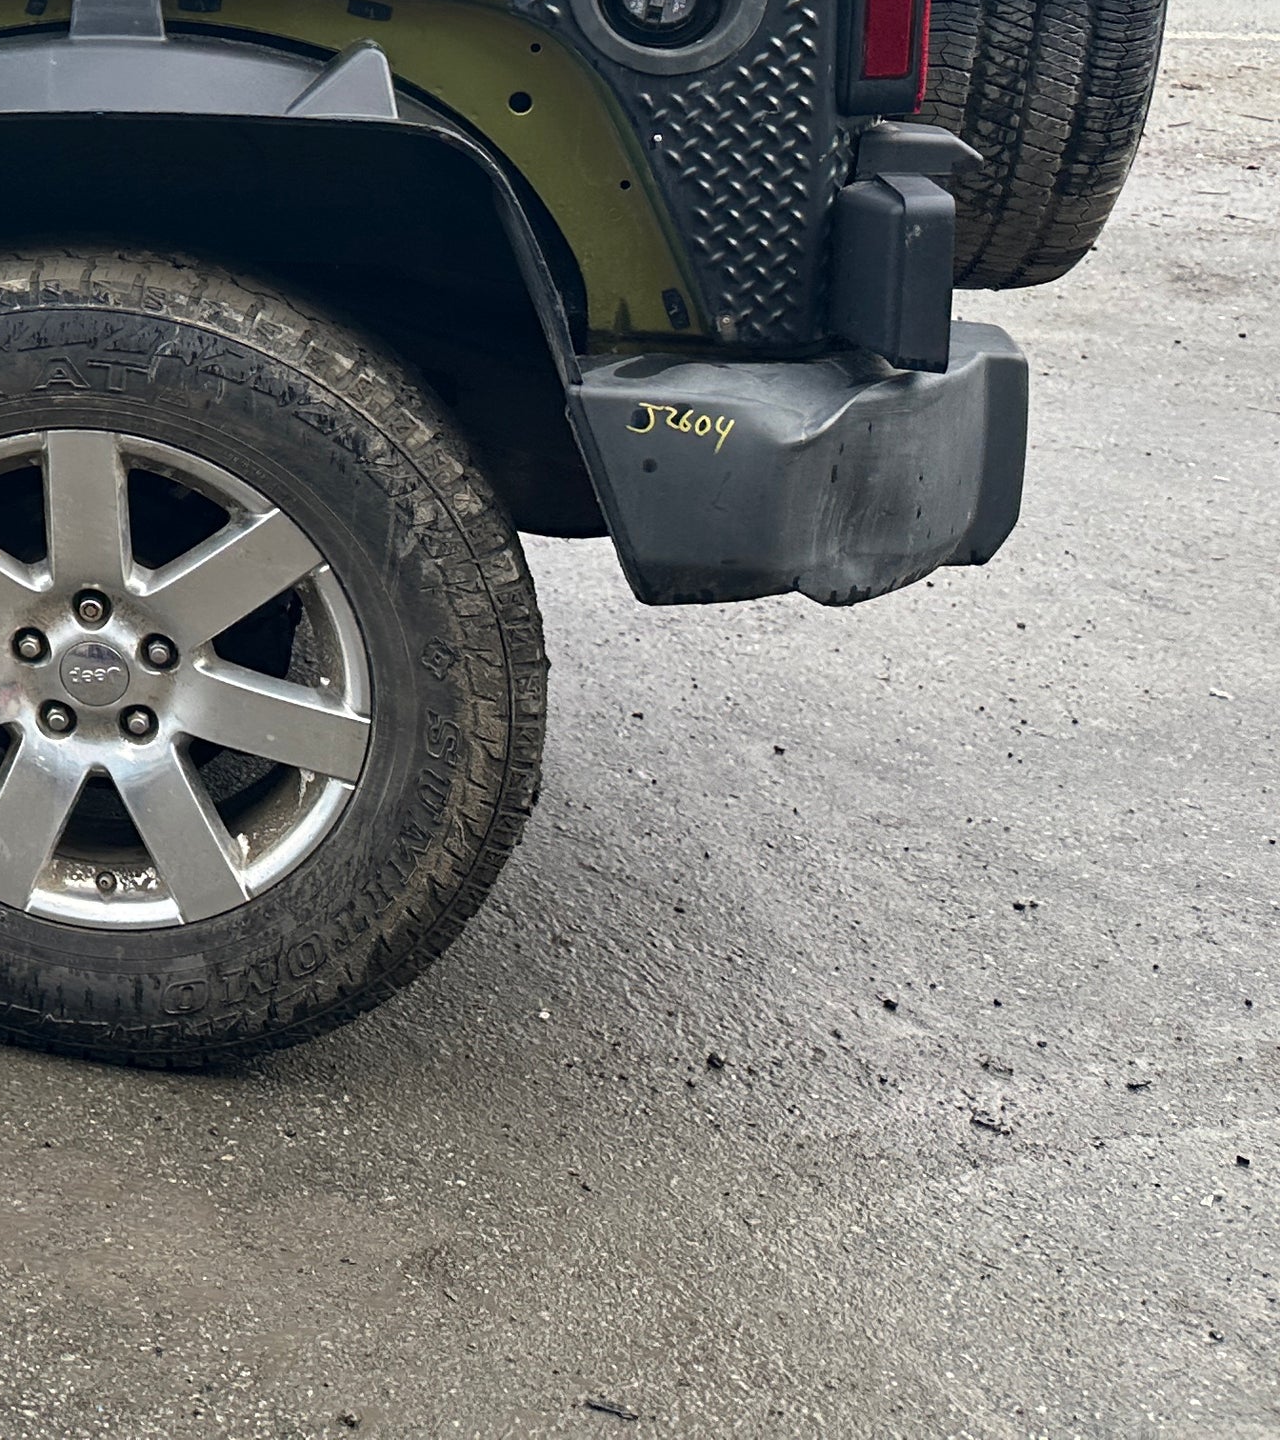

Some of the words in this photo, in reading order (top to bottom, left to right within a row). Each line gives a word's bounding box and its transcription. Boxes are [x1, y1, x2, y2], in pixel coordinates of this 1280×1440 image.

[35, 357, 152, 393] AT
[625, 402, 735, 456] J2604
[160, 706, 464, 1016] SUMITOMO
